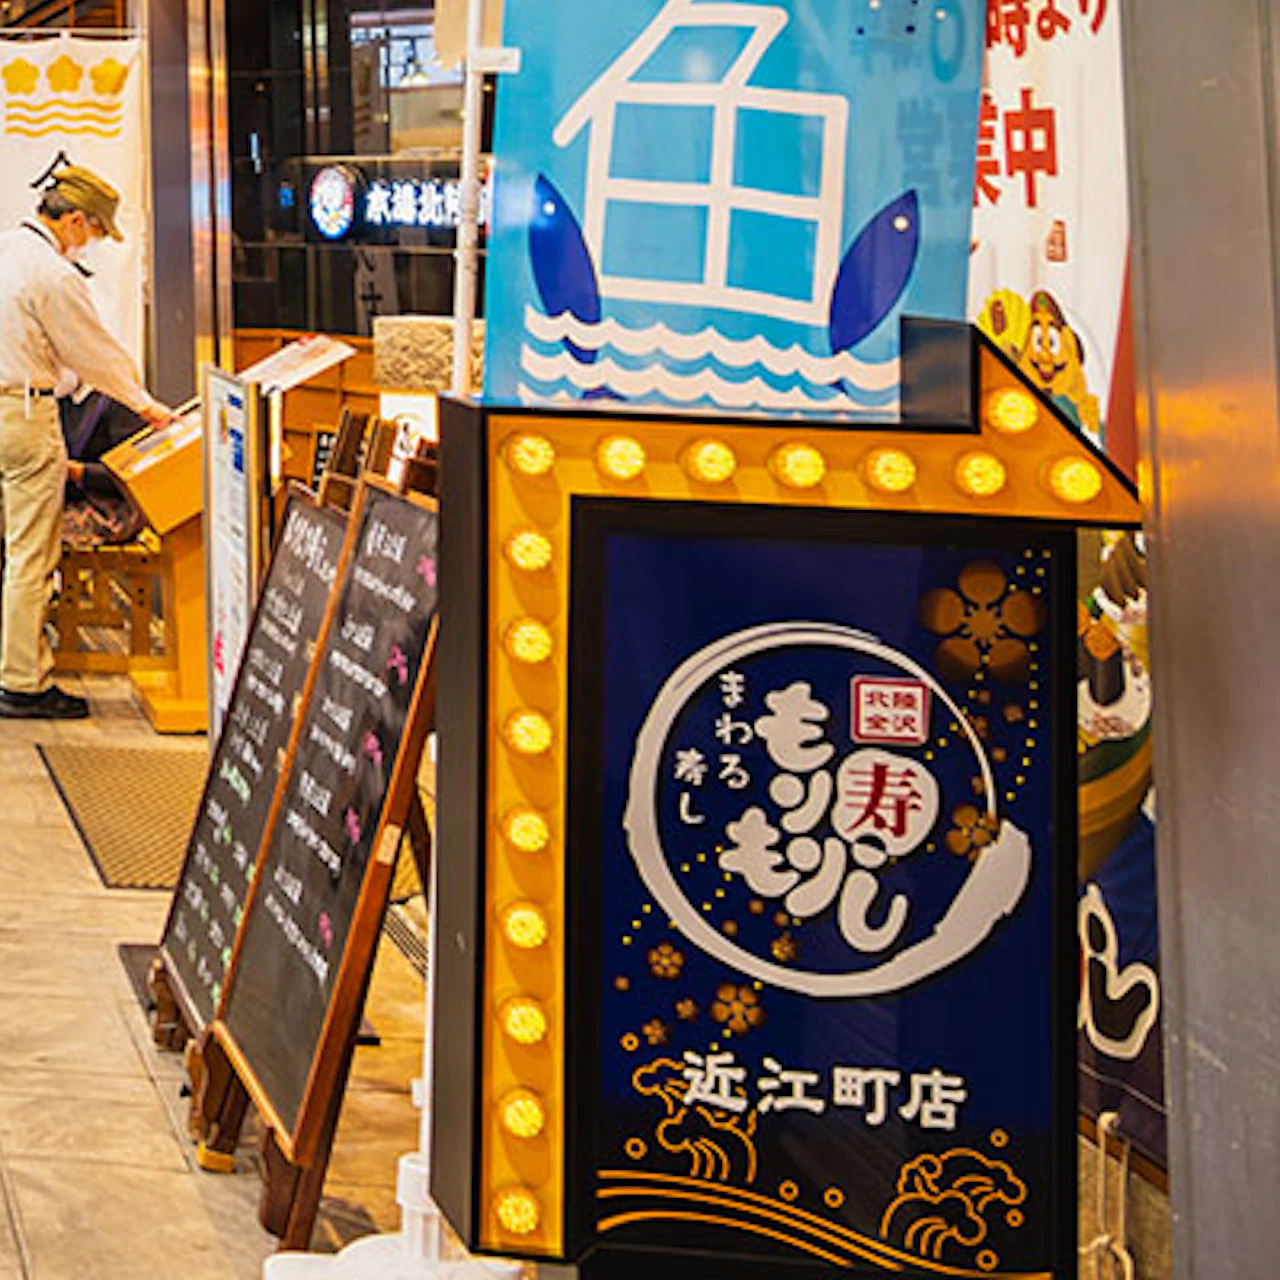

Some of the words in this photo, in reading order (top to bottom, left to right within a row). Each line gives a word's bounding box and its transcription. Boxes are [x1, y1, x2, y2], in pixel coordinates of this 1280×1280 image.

[715, 670, 754, 790] まわる
[865, 691, 919, 709] 北陸
[680, 1050, 969, 1130] 近江町店
